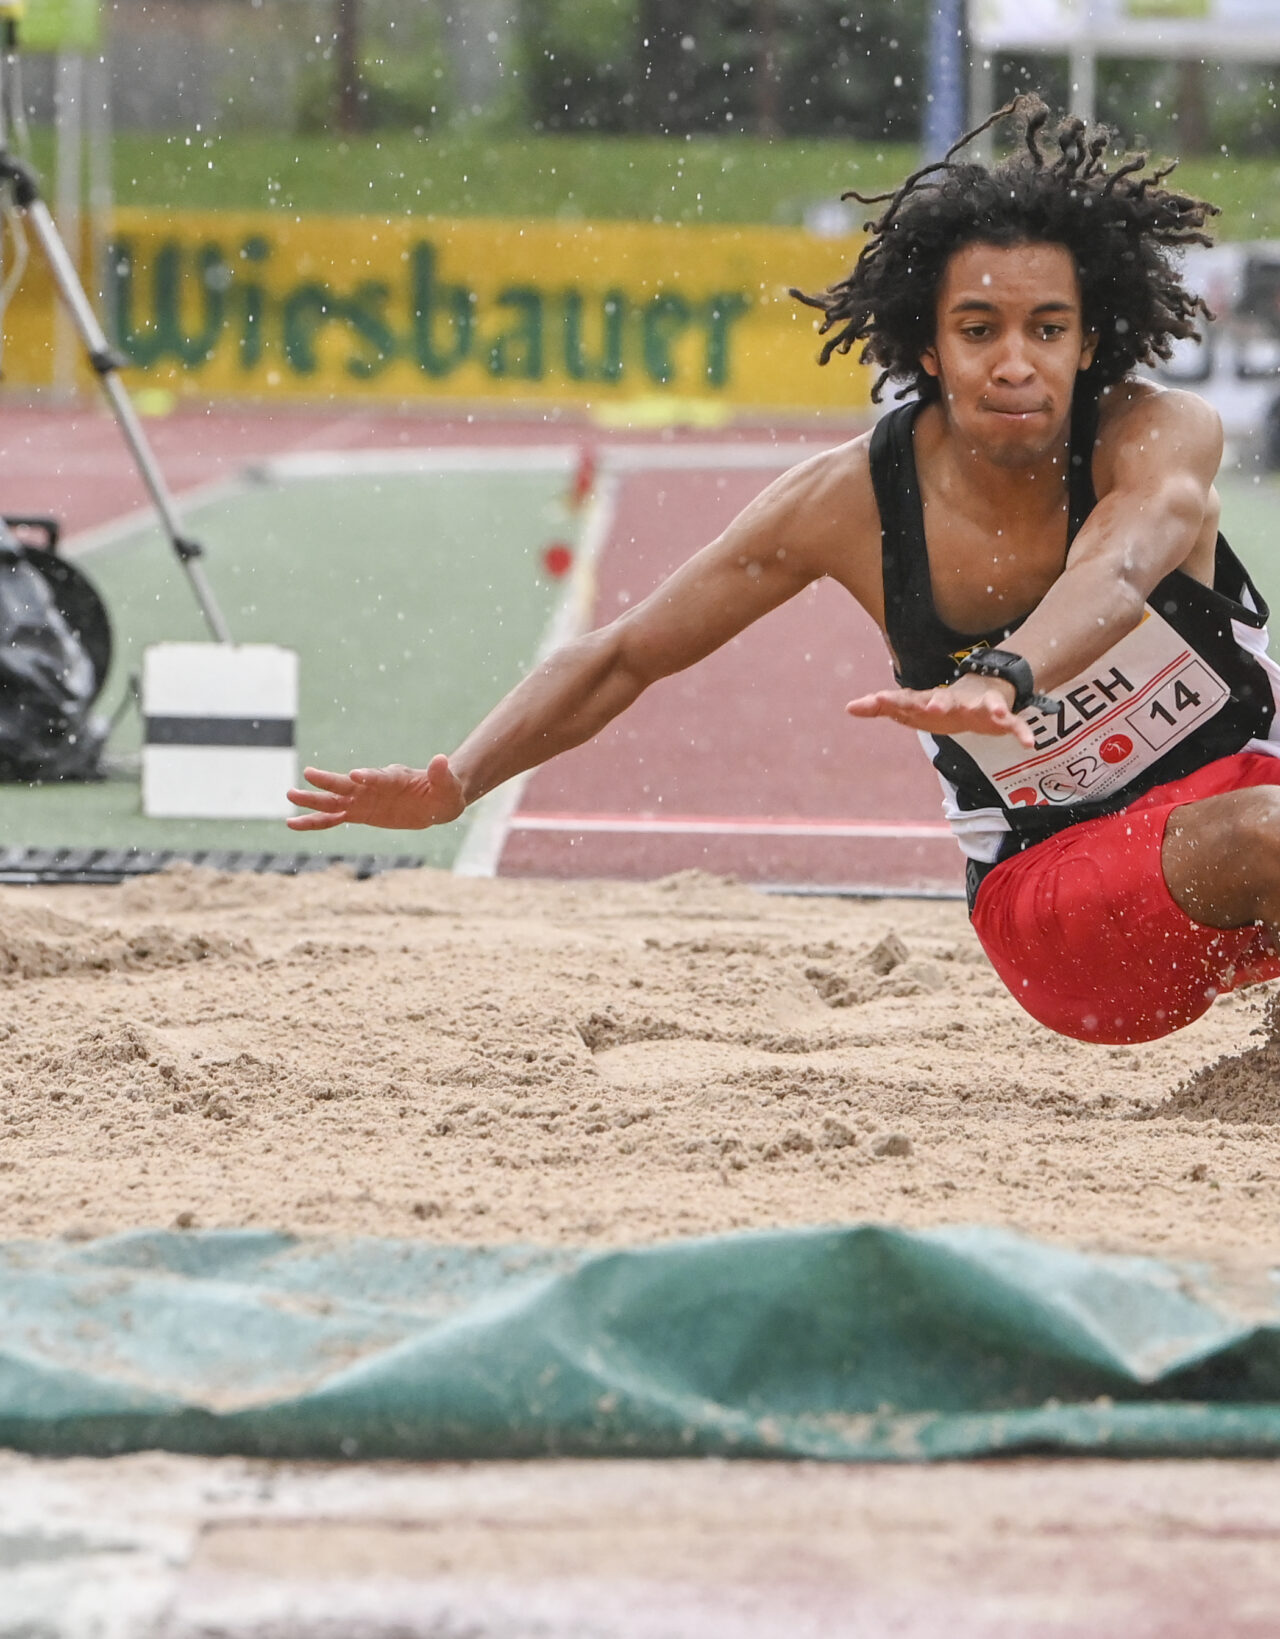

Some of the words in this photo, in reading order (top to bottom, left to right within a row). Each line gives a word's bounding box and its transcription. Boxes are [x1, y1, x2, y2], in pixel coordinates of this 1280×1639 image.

[104, 235, 750, 389] Wiesbauer
[1027, 667, 1135, 751] EZEH
[1149, 679, 1201, 726] 14
